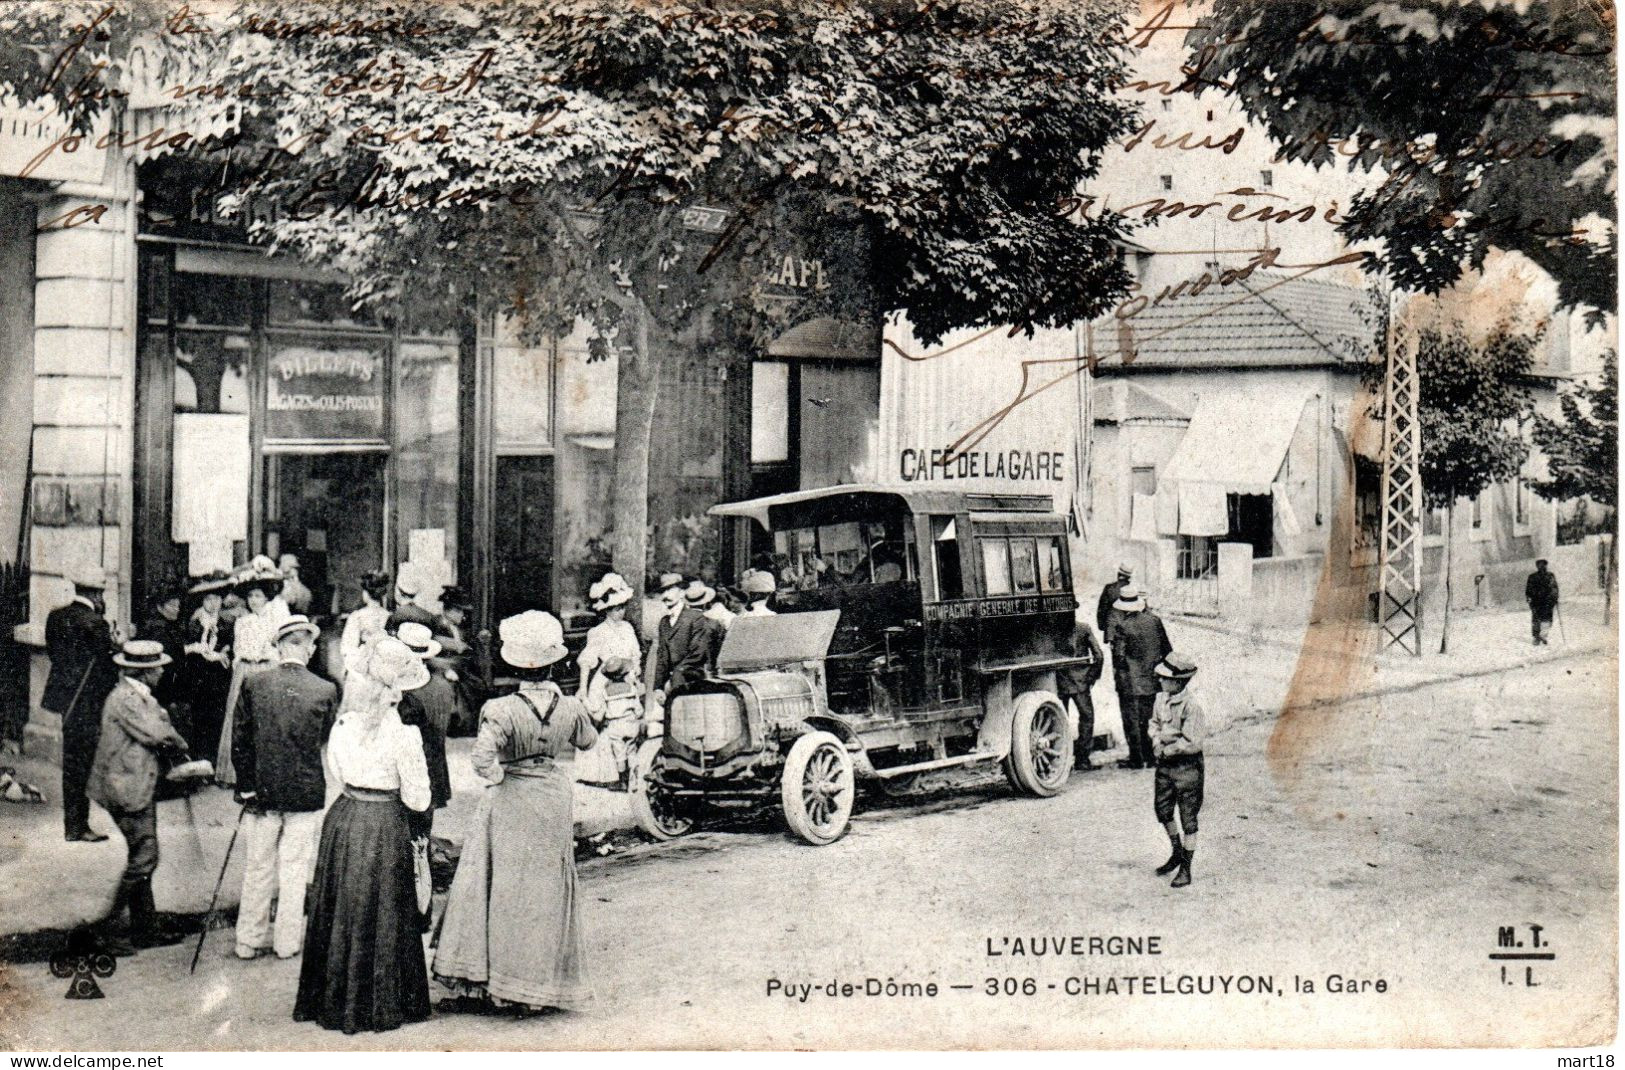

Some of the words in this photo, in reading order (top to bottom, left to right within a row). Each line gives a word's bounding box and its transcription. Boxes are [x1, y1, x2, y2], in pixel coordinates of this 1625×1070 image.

[900, 444, 954, 482] CAFÉ
[958, 452, 979, 478] DE
[985, 451, 1005, 478] LA
[1008, 450, 1064, 481] GARE
